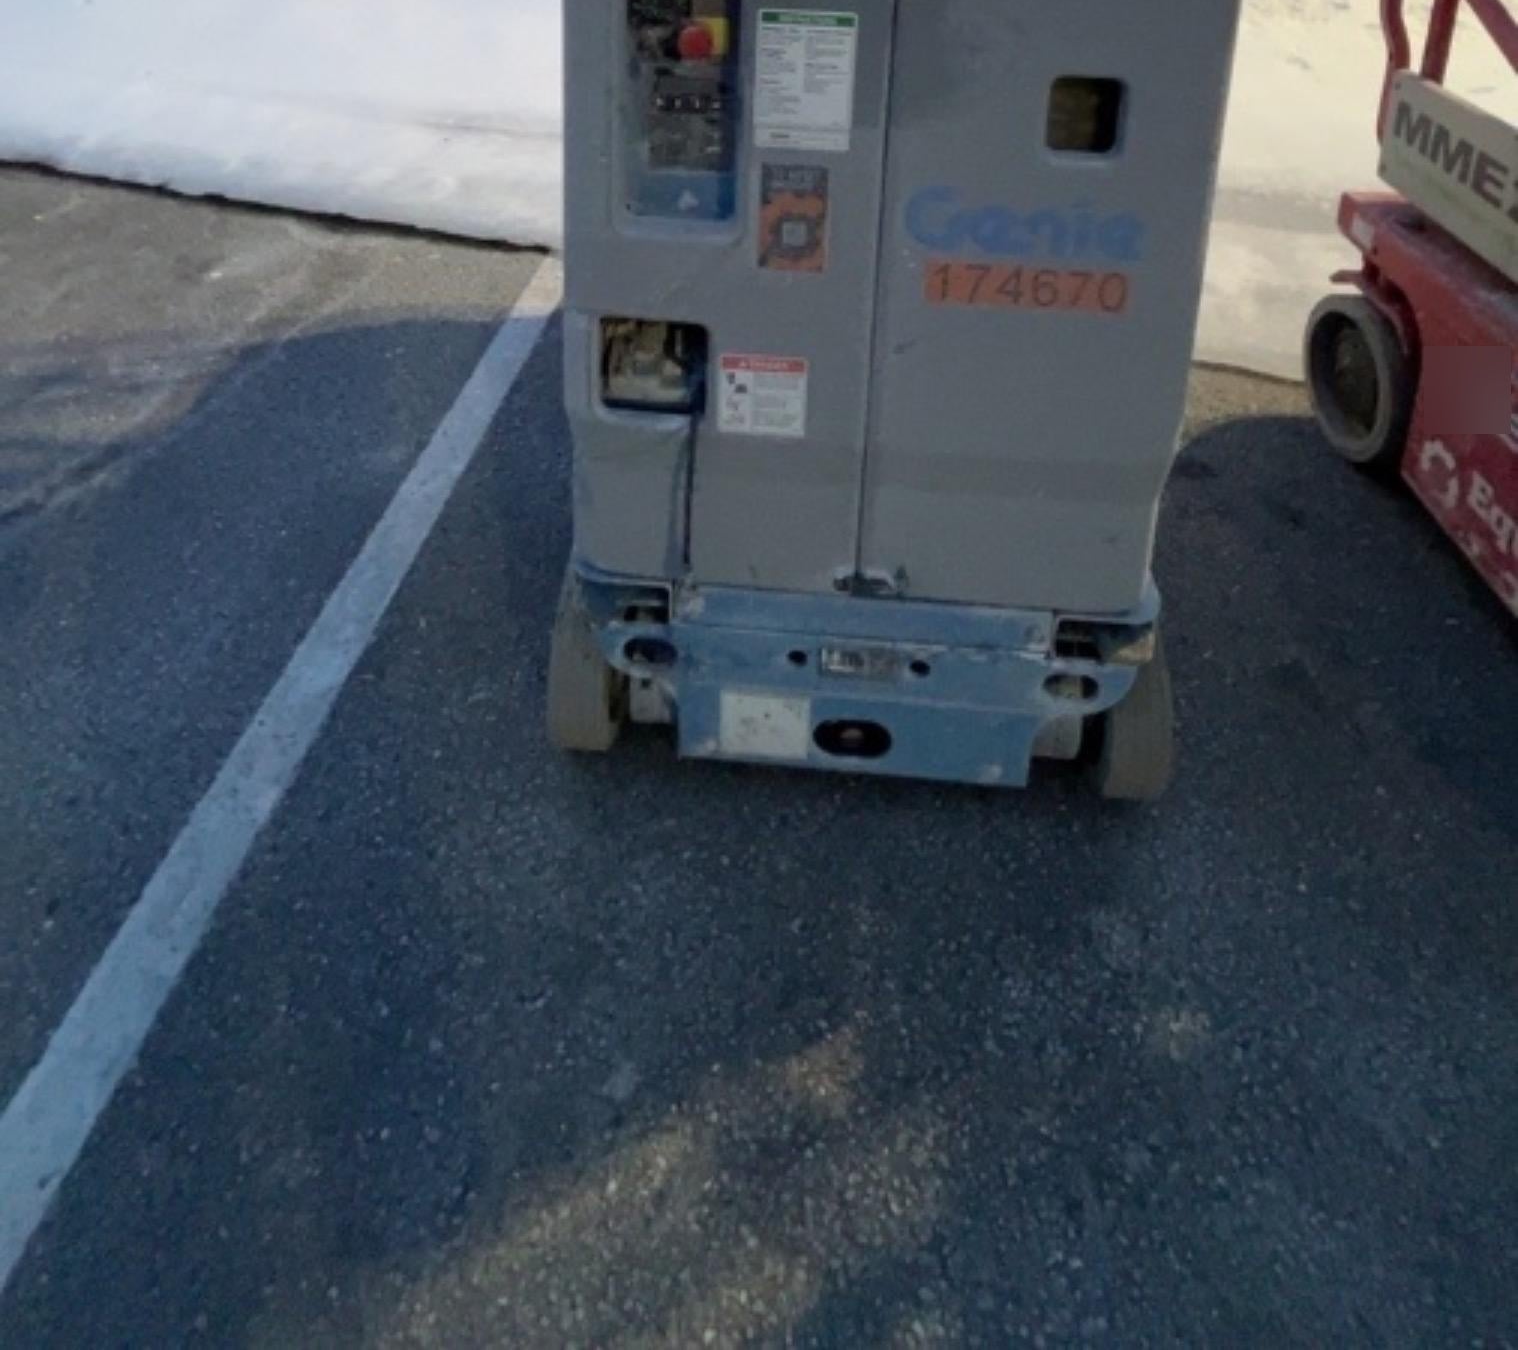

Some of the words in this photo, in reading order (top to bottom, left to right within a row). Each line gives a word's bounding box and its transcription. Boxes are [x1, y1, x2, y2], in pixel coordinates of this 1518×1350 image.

[905, 185, 1144, 261] Genie
[933, 262, 1129, 313] 174670
[1467, 469, 1518, 558] Eq
